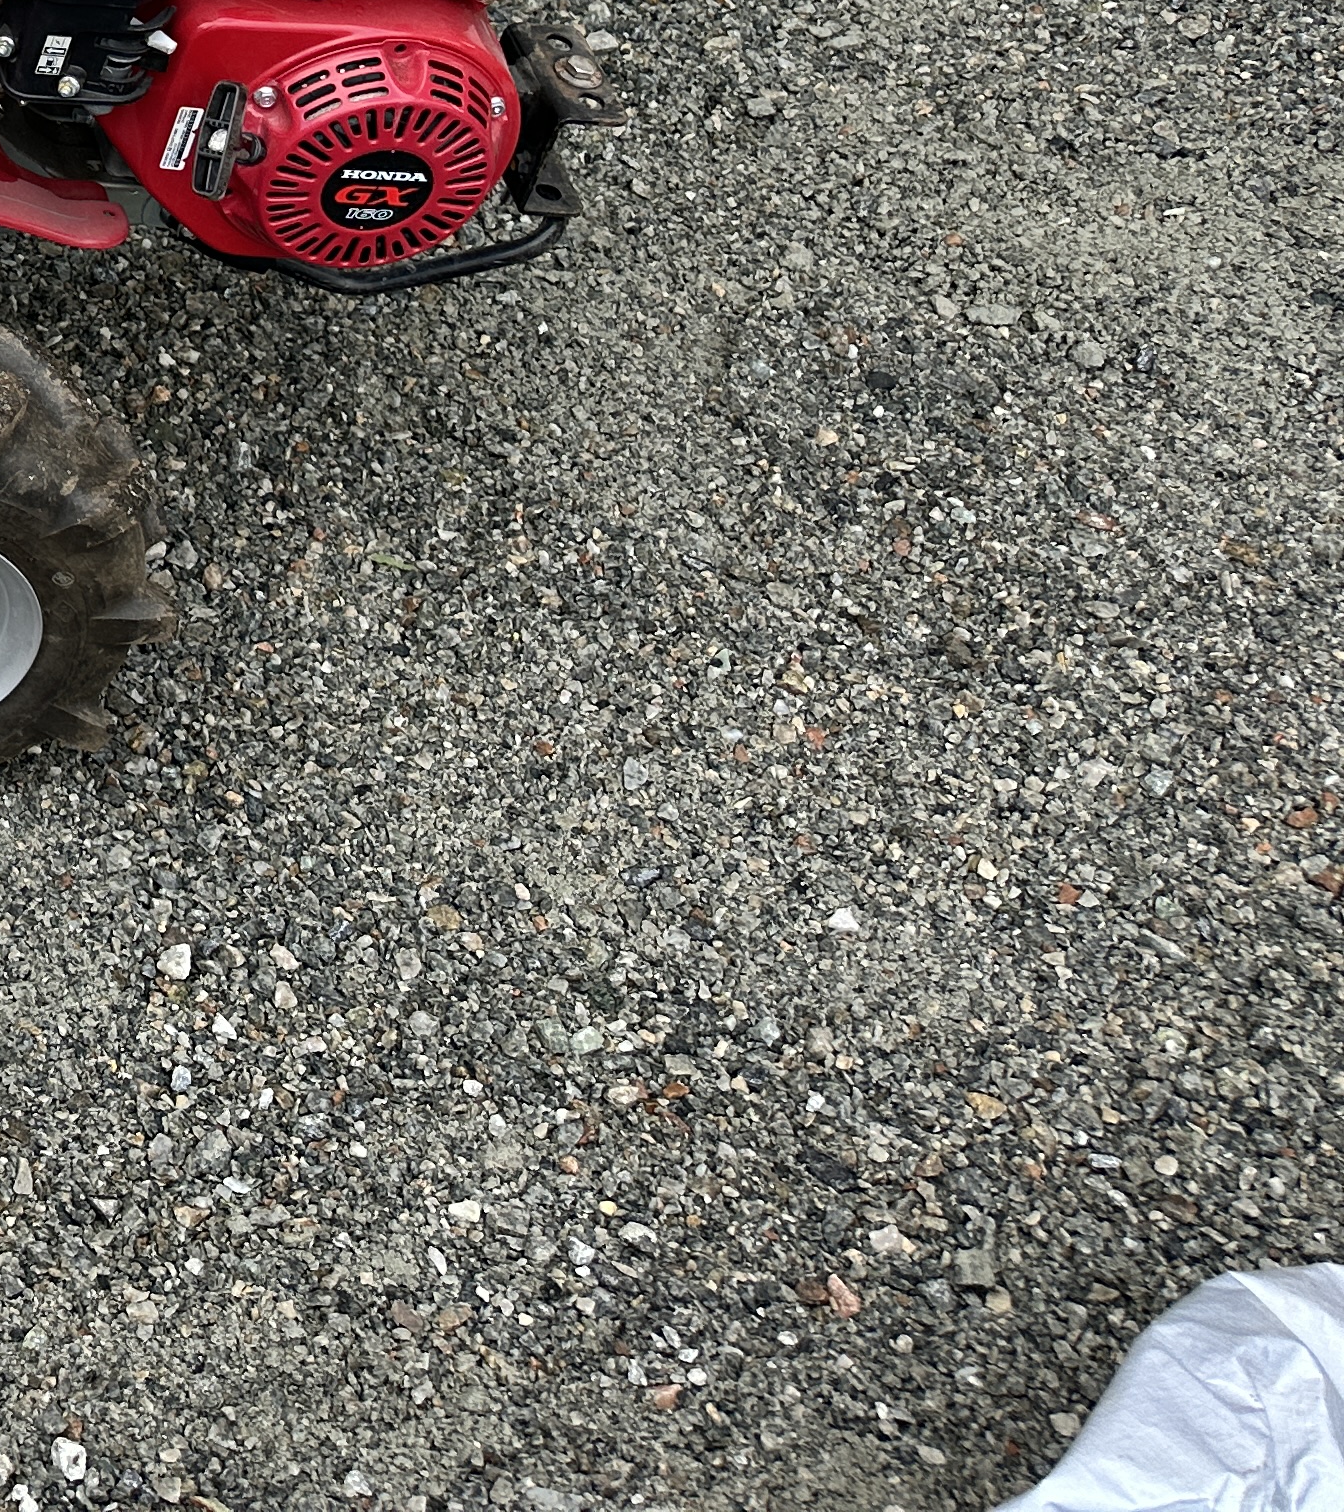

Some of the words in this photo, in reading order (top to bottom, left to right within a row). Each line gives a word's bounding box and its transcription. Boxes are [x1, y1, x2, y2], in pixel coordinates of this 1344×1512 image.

[340, 169, 427, 183] HONDA
[334, 184, 419, 207] GX
[345, 207, 394, 220] 160
